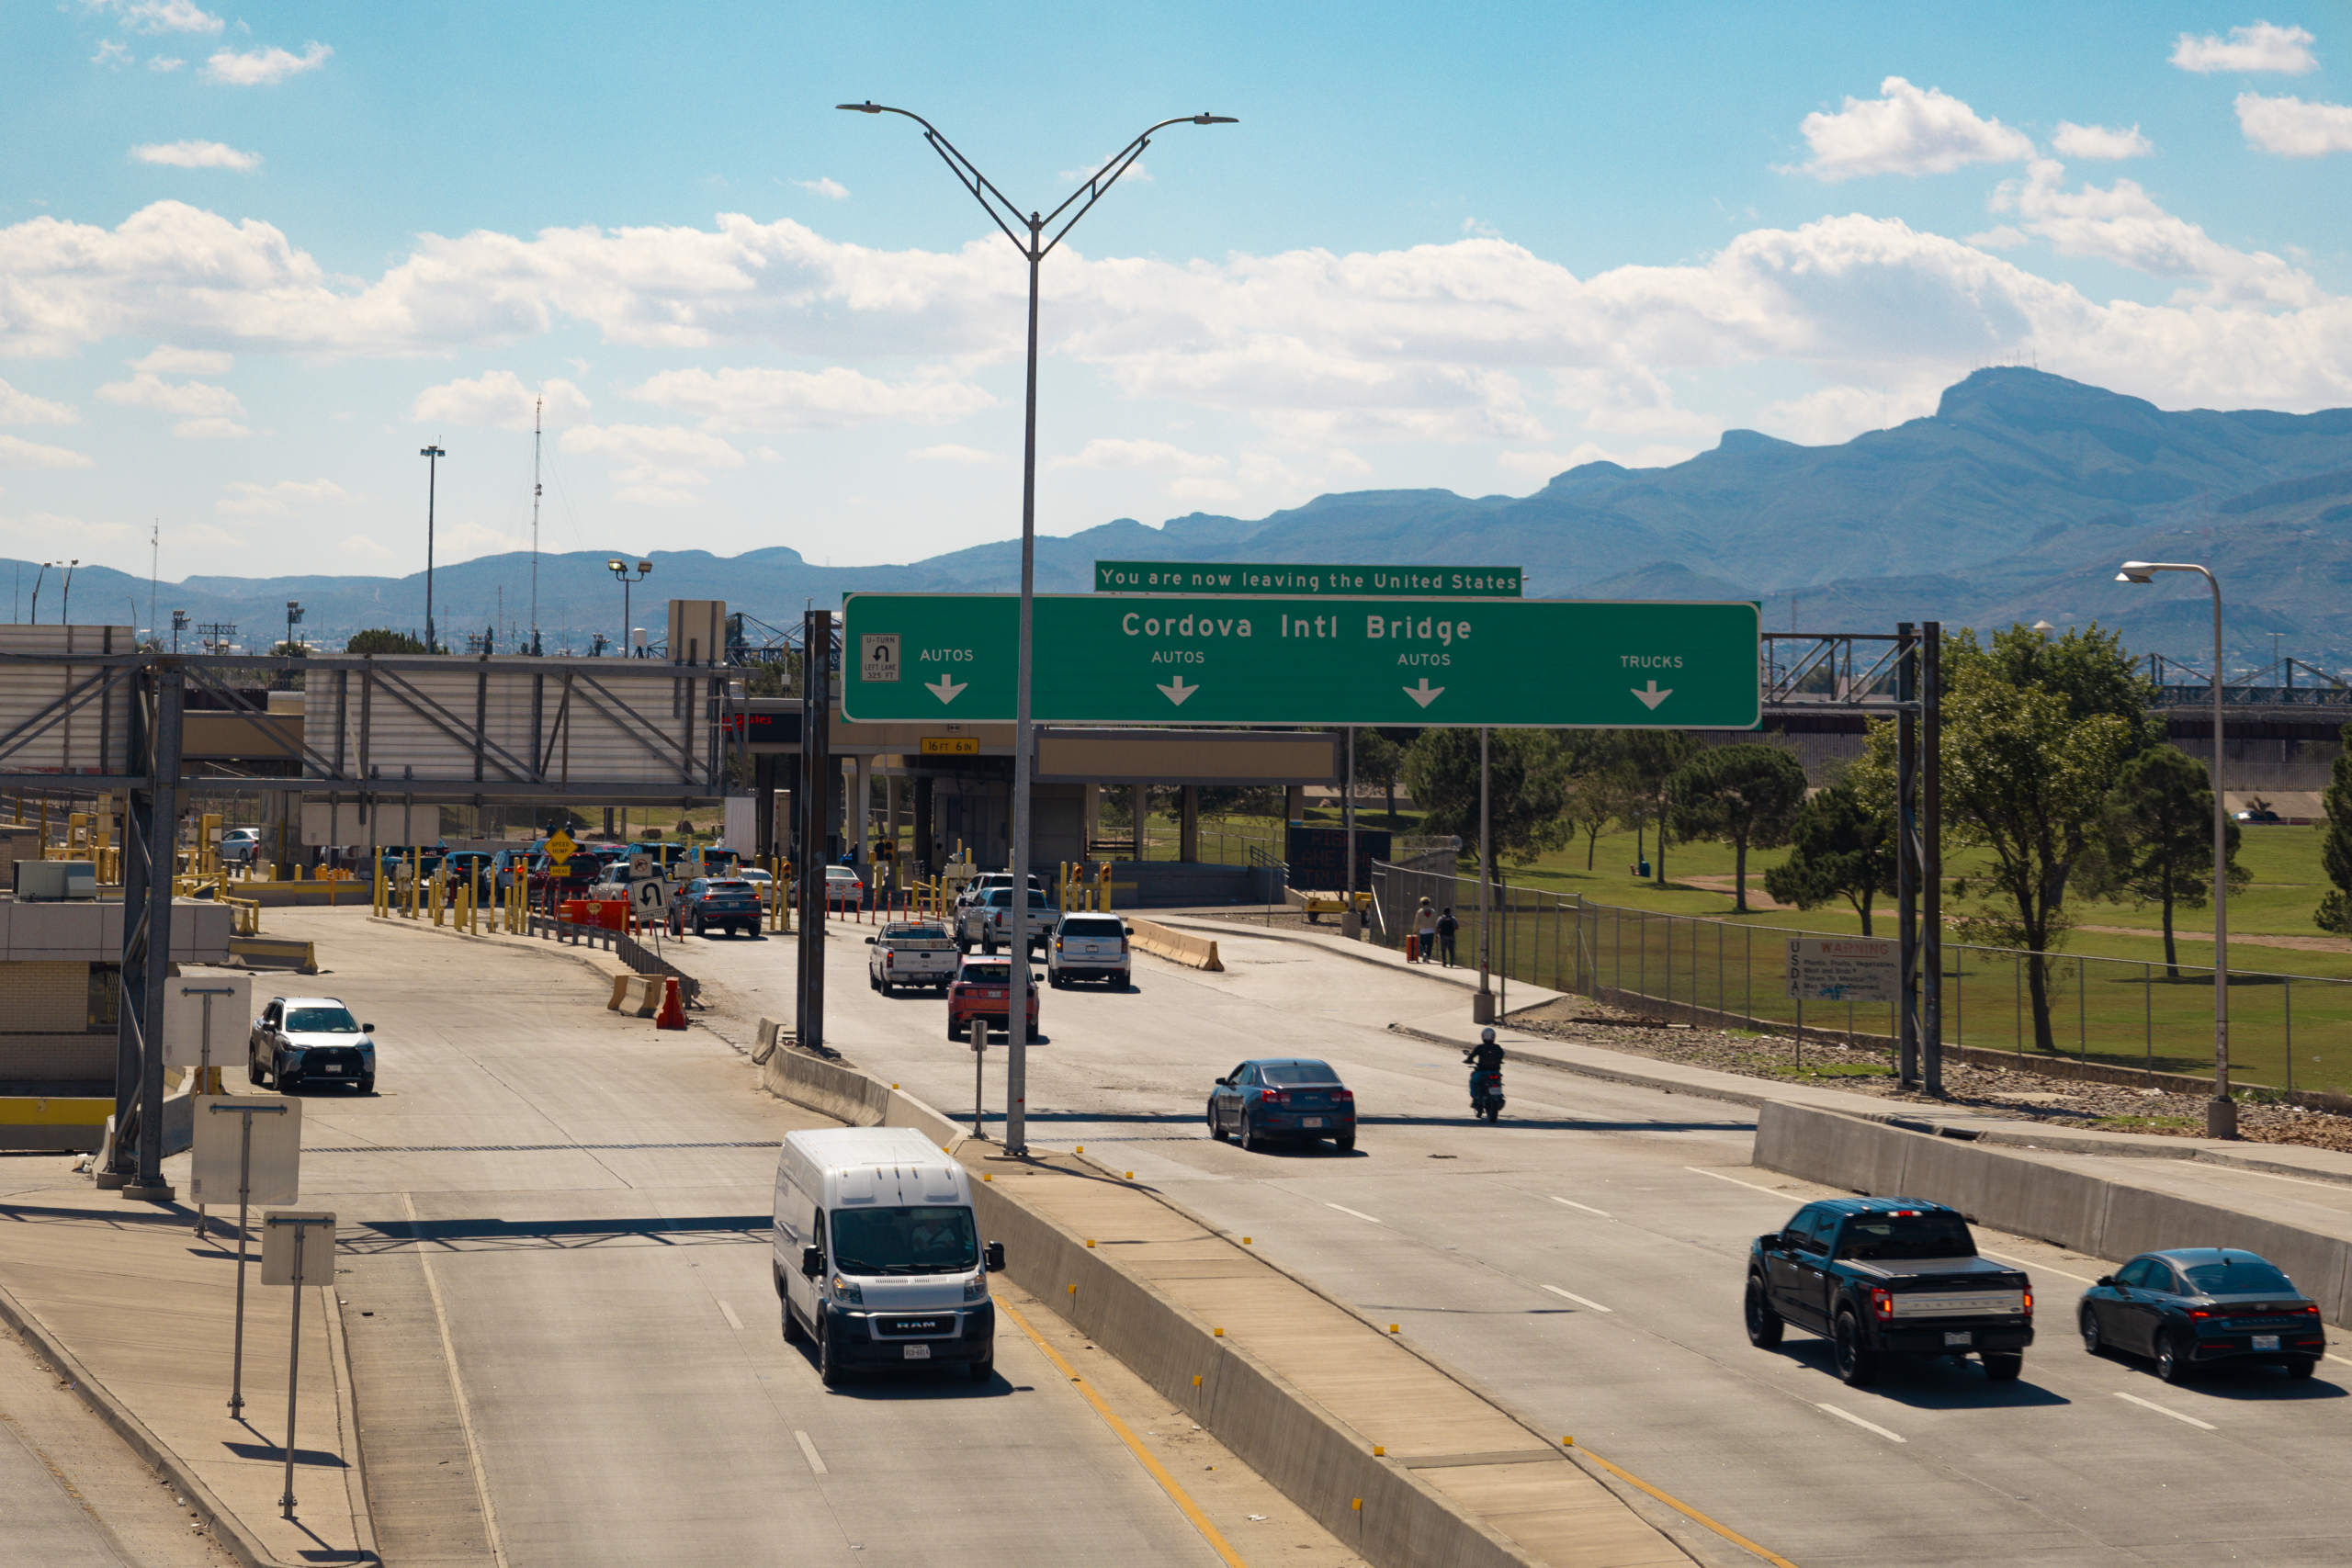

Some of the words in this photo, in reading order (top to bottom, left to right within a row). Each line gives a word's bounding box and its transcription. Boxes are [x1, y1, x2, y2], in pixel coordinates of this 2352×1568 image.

[1101, 569, 1139, 585] You
[1148, 572, 1182, 585] are
[1192, 573, 1232, 586] now
[1242, 571, 1319, 592] leaving
[1329, 573, 1363, 588] the
[1374, 573, 1442, 589] United
[1452, 574, 1517, 590] States
[1122, 612, 1252, 637] Cordova
[1282, 614, 1337, 637] Intl
[1367, 615, 1472, 647] Bridge
[920, 649, 974, 661] AUTOS
[1151, 650, 1205, 663] AUTOS
[1397, 653, 1452, 666] AUTOS
[1620, 655, 1683, 669] TRUCKS
[736, 714, 772, 724] Sates
[929, 740, 938, 751] 16
[956, 741, 962, 751] 6
[1290, 849, 1336, 866] LANE
[639, 909, 666, 919] PERMITTED
[1820, 942, 1889, 955] WARNING
[1913, 1300, 2005, 1308] PLATINUM
